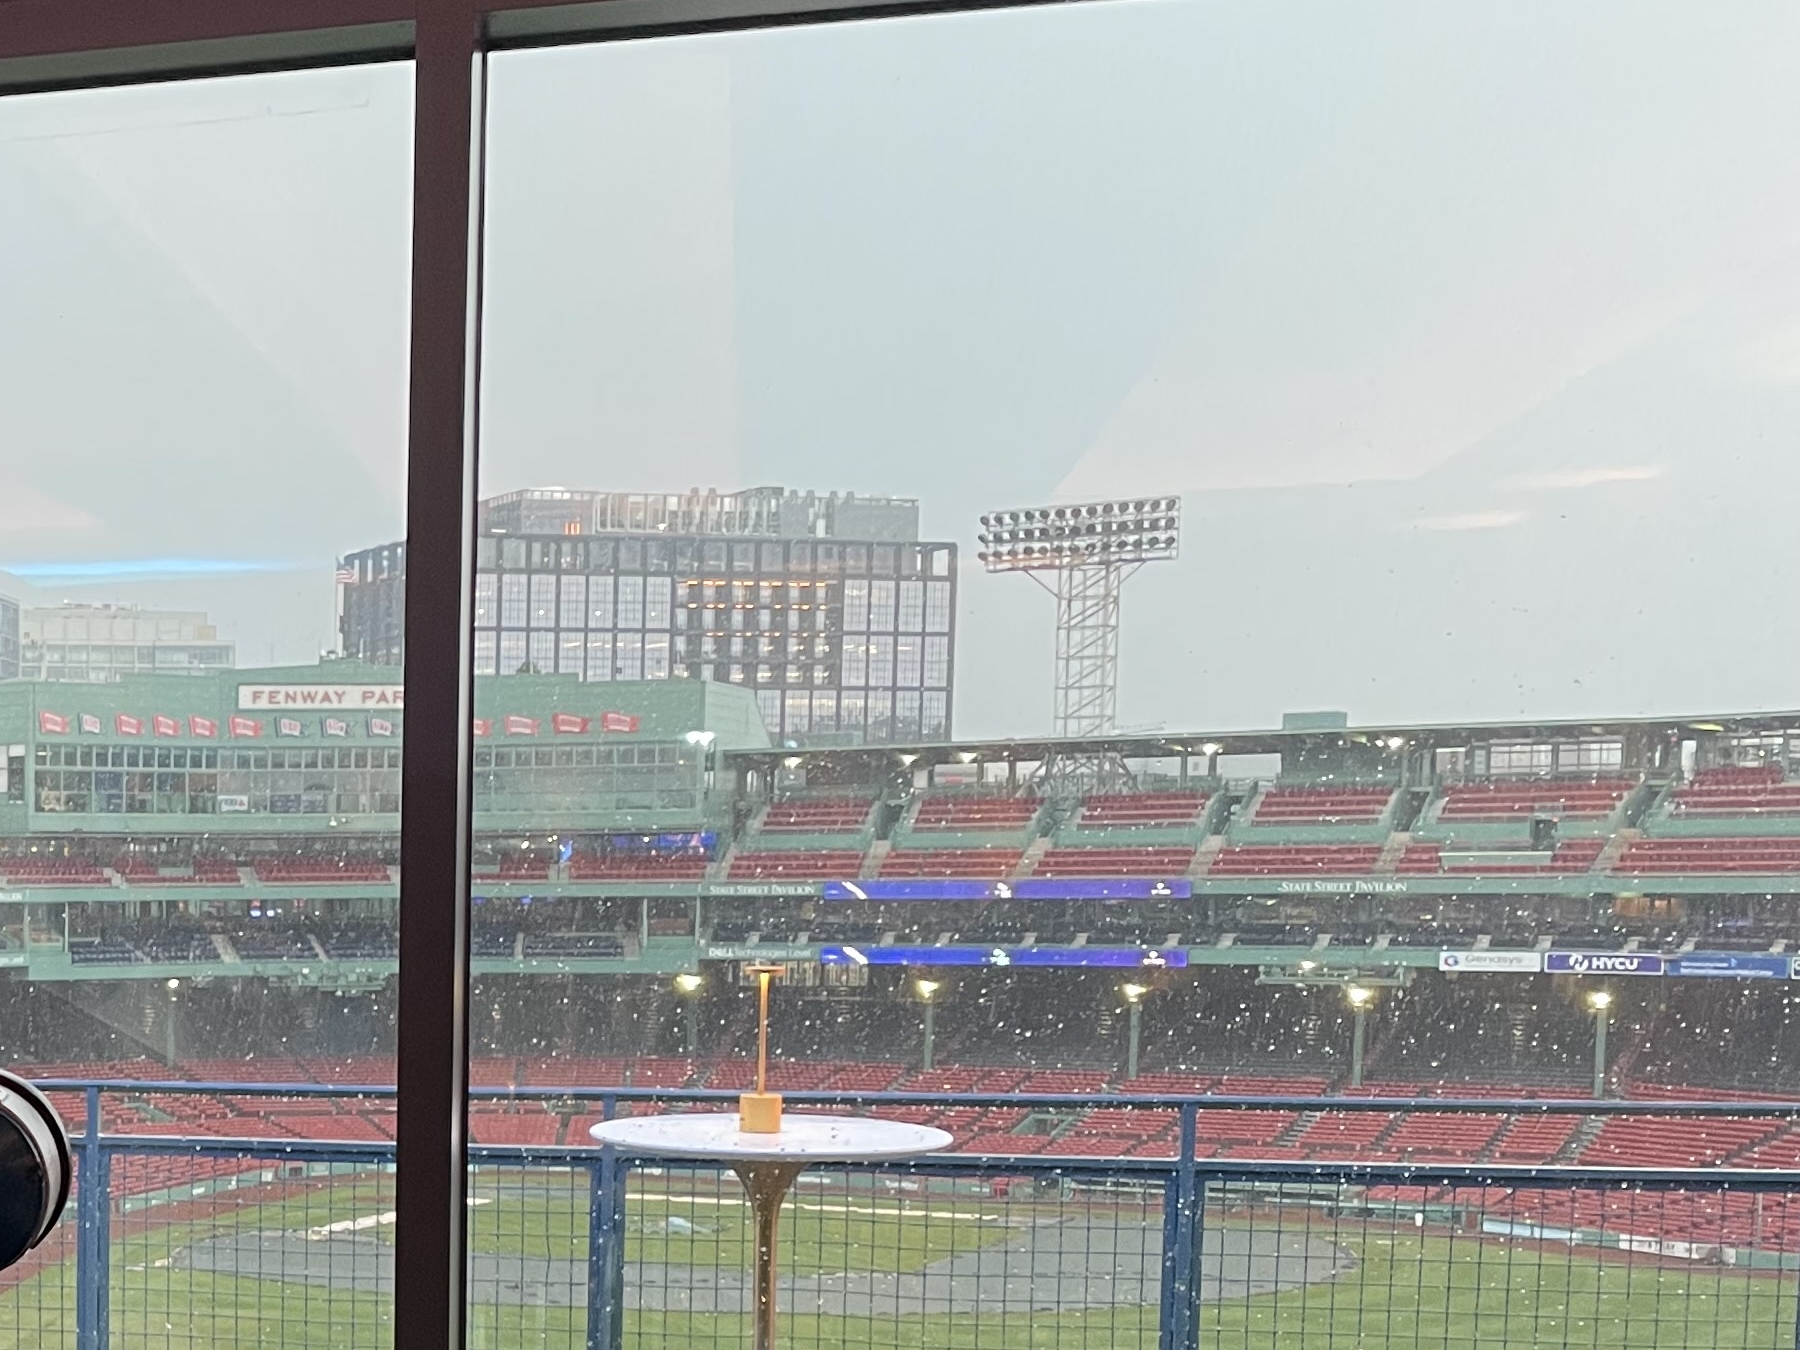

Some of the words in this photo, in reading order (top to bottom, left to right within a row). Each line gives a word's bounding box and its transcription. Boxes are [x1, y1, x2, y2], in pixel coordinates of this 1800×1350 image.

[251, 690, 346, 705] FENWAY
[771, 884, 815, 895] PAVILION
[1281, 881, 1312, 892] STATE
[1314, 881, 1352, 892] STREET
[1355, 881, 1408, 893] PAVILION
[1464, 953, 1524, 965] Genasys
[1592, 957, 1639, 970] HYCU
